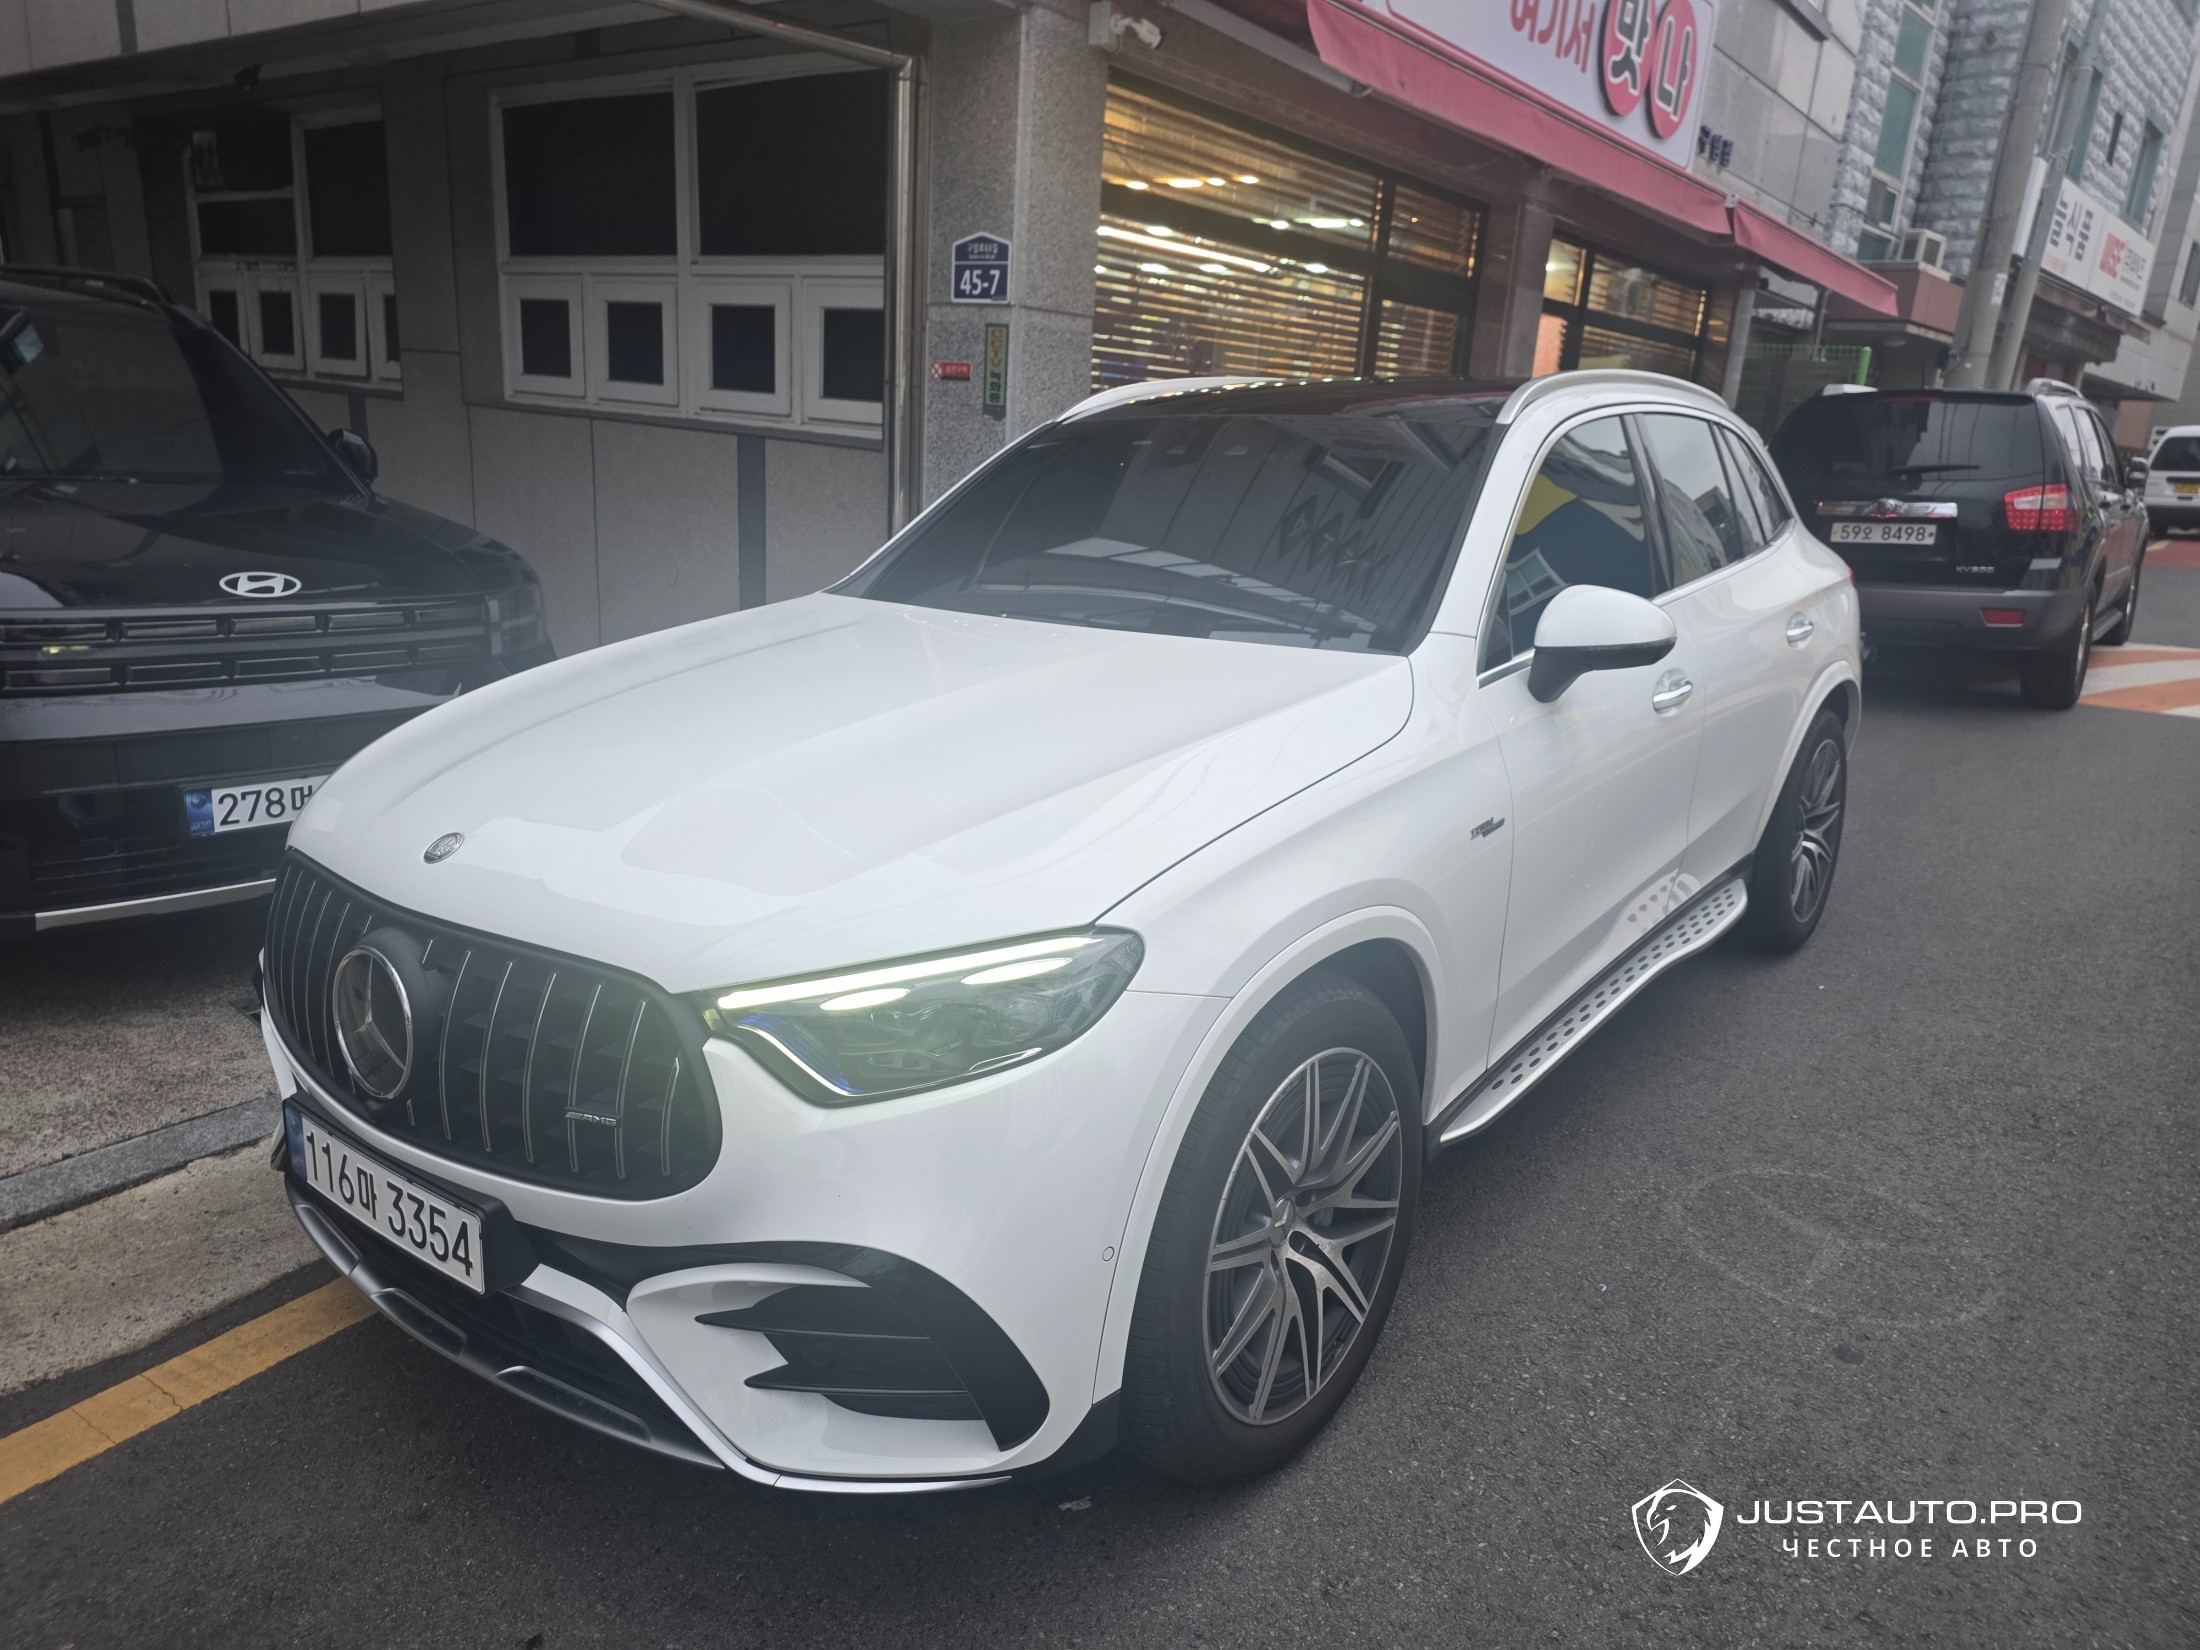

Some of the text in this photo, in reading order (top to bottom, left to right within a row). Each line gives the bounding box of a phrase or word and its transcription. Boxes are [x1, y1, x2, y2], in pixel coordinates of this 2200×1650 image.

[960, 269, 1000, 295] 45-7
[991, 328, 1004, 368] CCTV
[1881, 525, 1926, 542] 8498
[306, 1131, 474, 1277] 116마 3354
